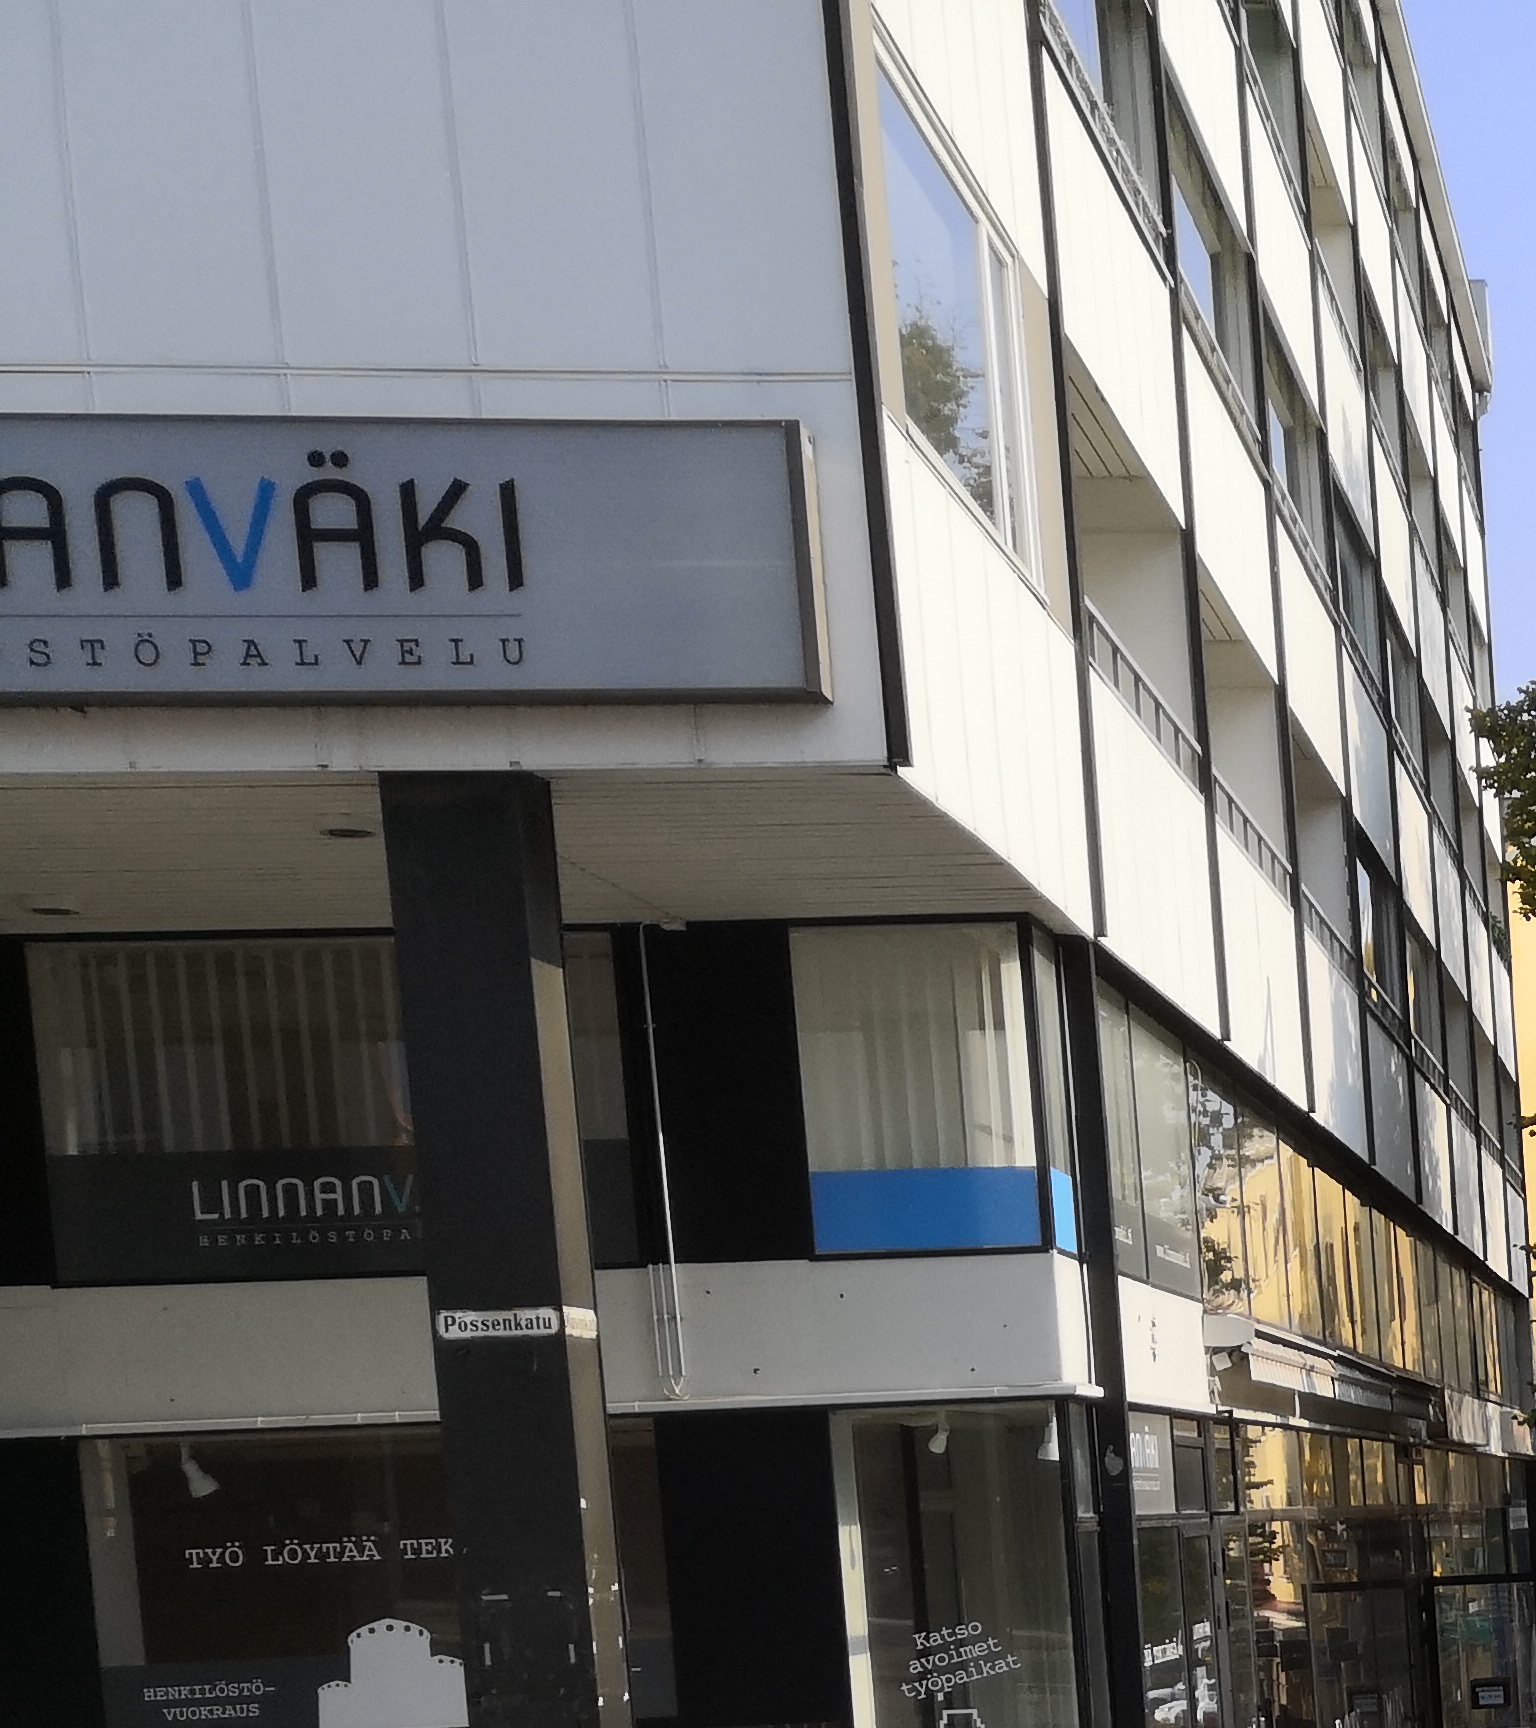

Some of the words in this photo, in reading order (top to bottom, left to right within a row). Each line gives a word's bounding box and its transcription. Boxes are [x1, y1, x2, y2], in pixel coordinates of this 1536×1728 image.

[27, 632, 526, 668] STÖPALVELU
[185, 1542, 243, 1568] TYÖ
[264, 1536, 381, 1565] LÖYTÄÄ
[912, 1622, 982, 1650] Katso
[909, 1637, 1002, 1674] avoimet
[143, 1679, 275, 1701] HENKILÖSTÖ-
[900, 1654, 1021, 1700] työpaikat
[163, 1704, 259, 1721] VUOKRAUS
